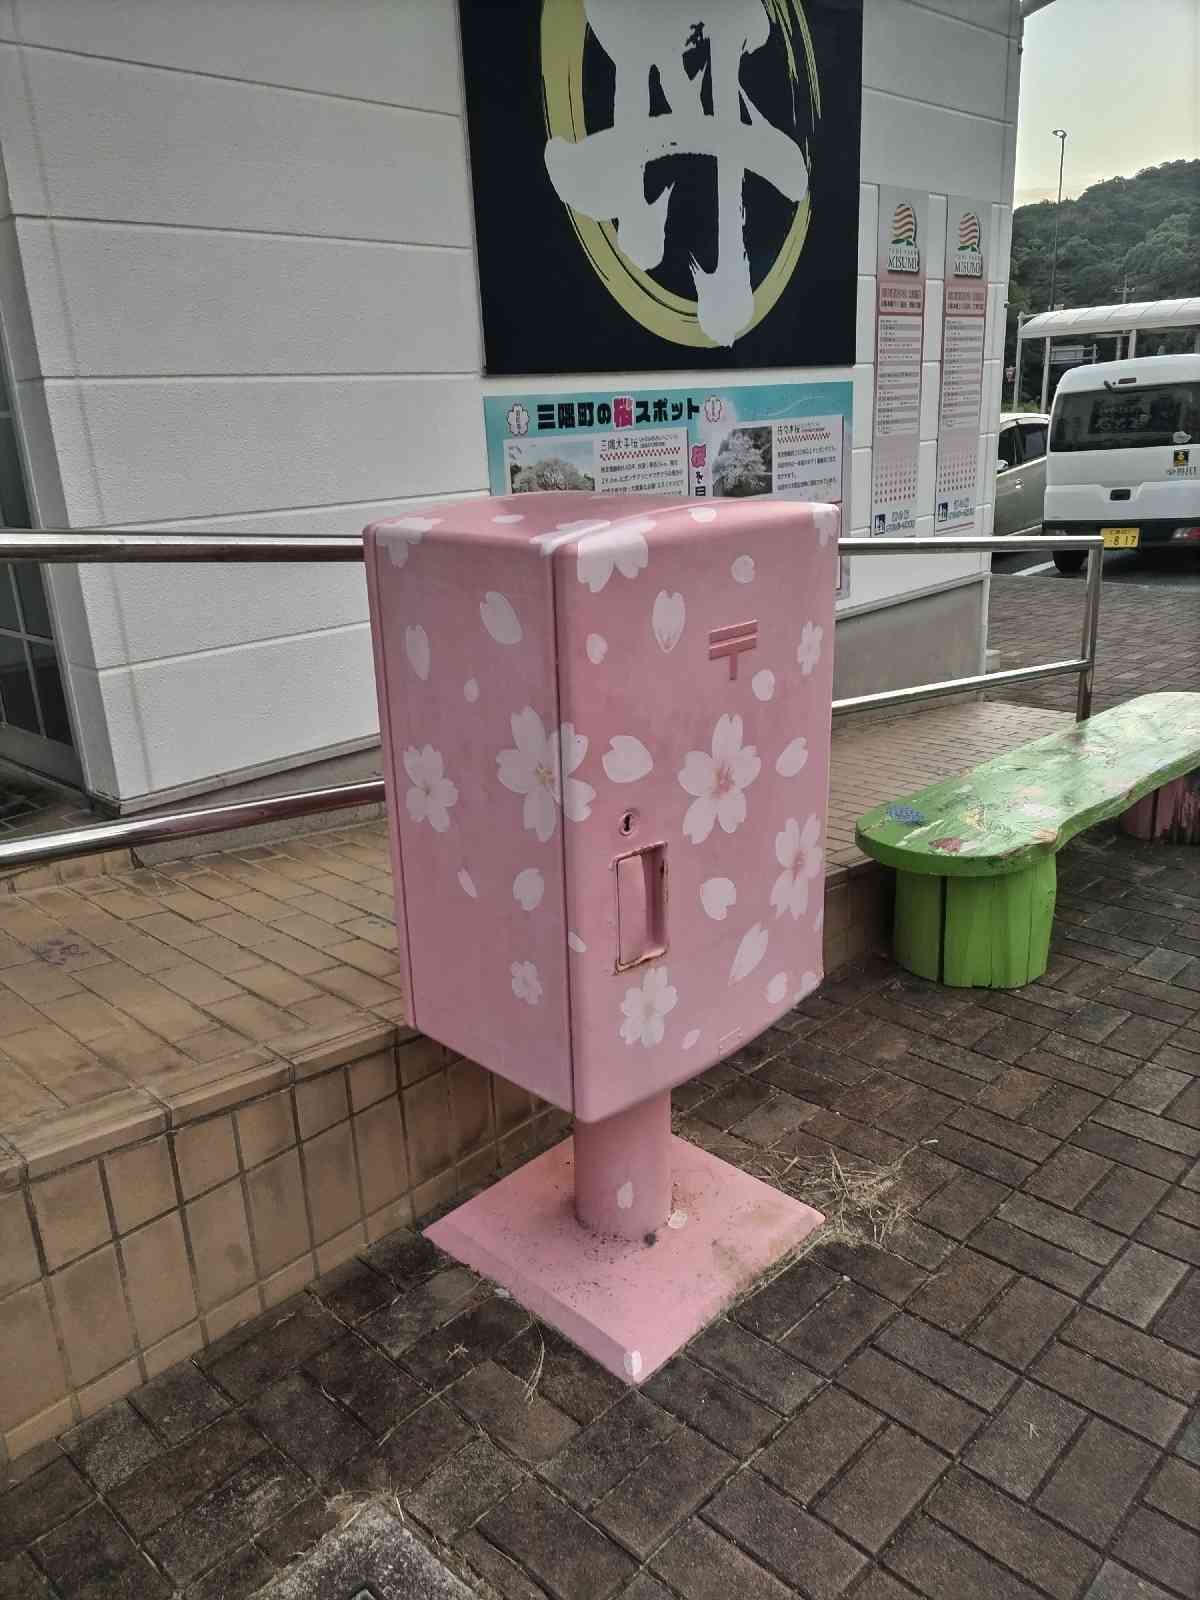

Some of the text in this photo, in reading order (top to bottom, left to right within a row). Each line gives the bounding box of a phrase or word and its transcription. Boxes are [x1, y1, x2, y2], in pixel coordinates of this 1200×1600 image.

[888, 256, 917, 269] MISUMI
[537, 396, 700, 430] 三隅町の桜スポット
